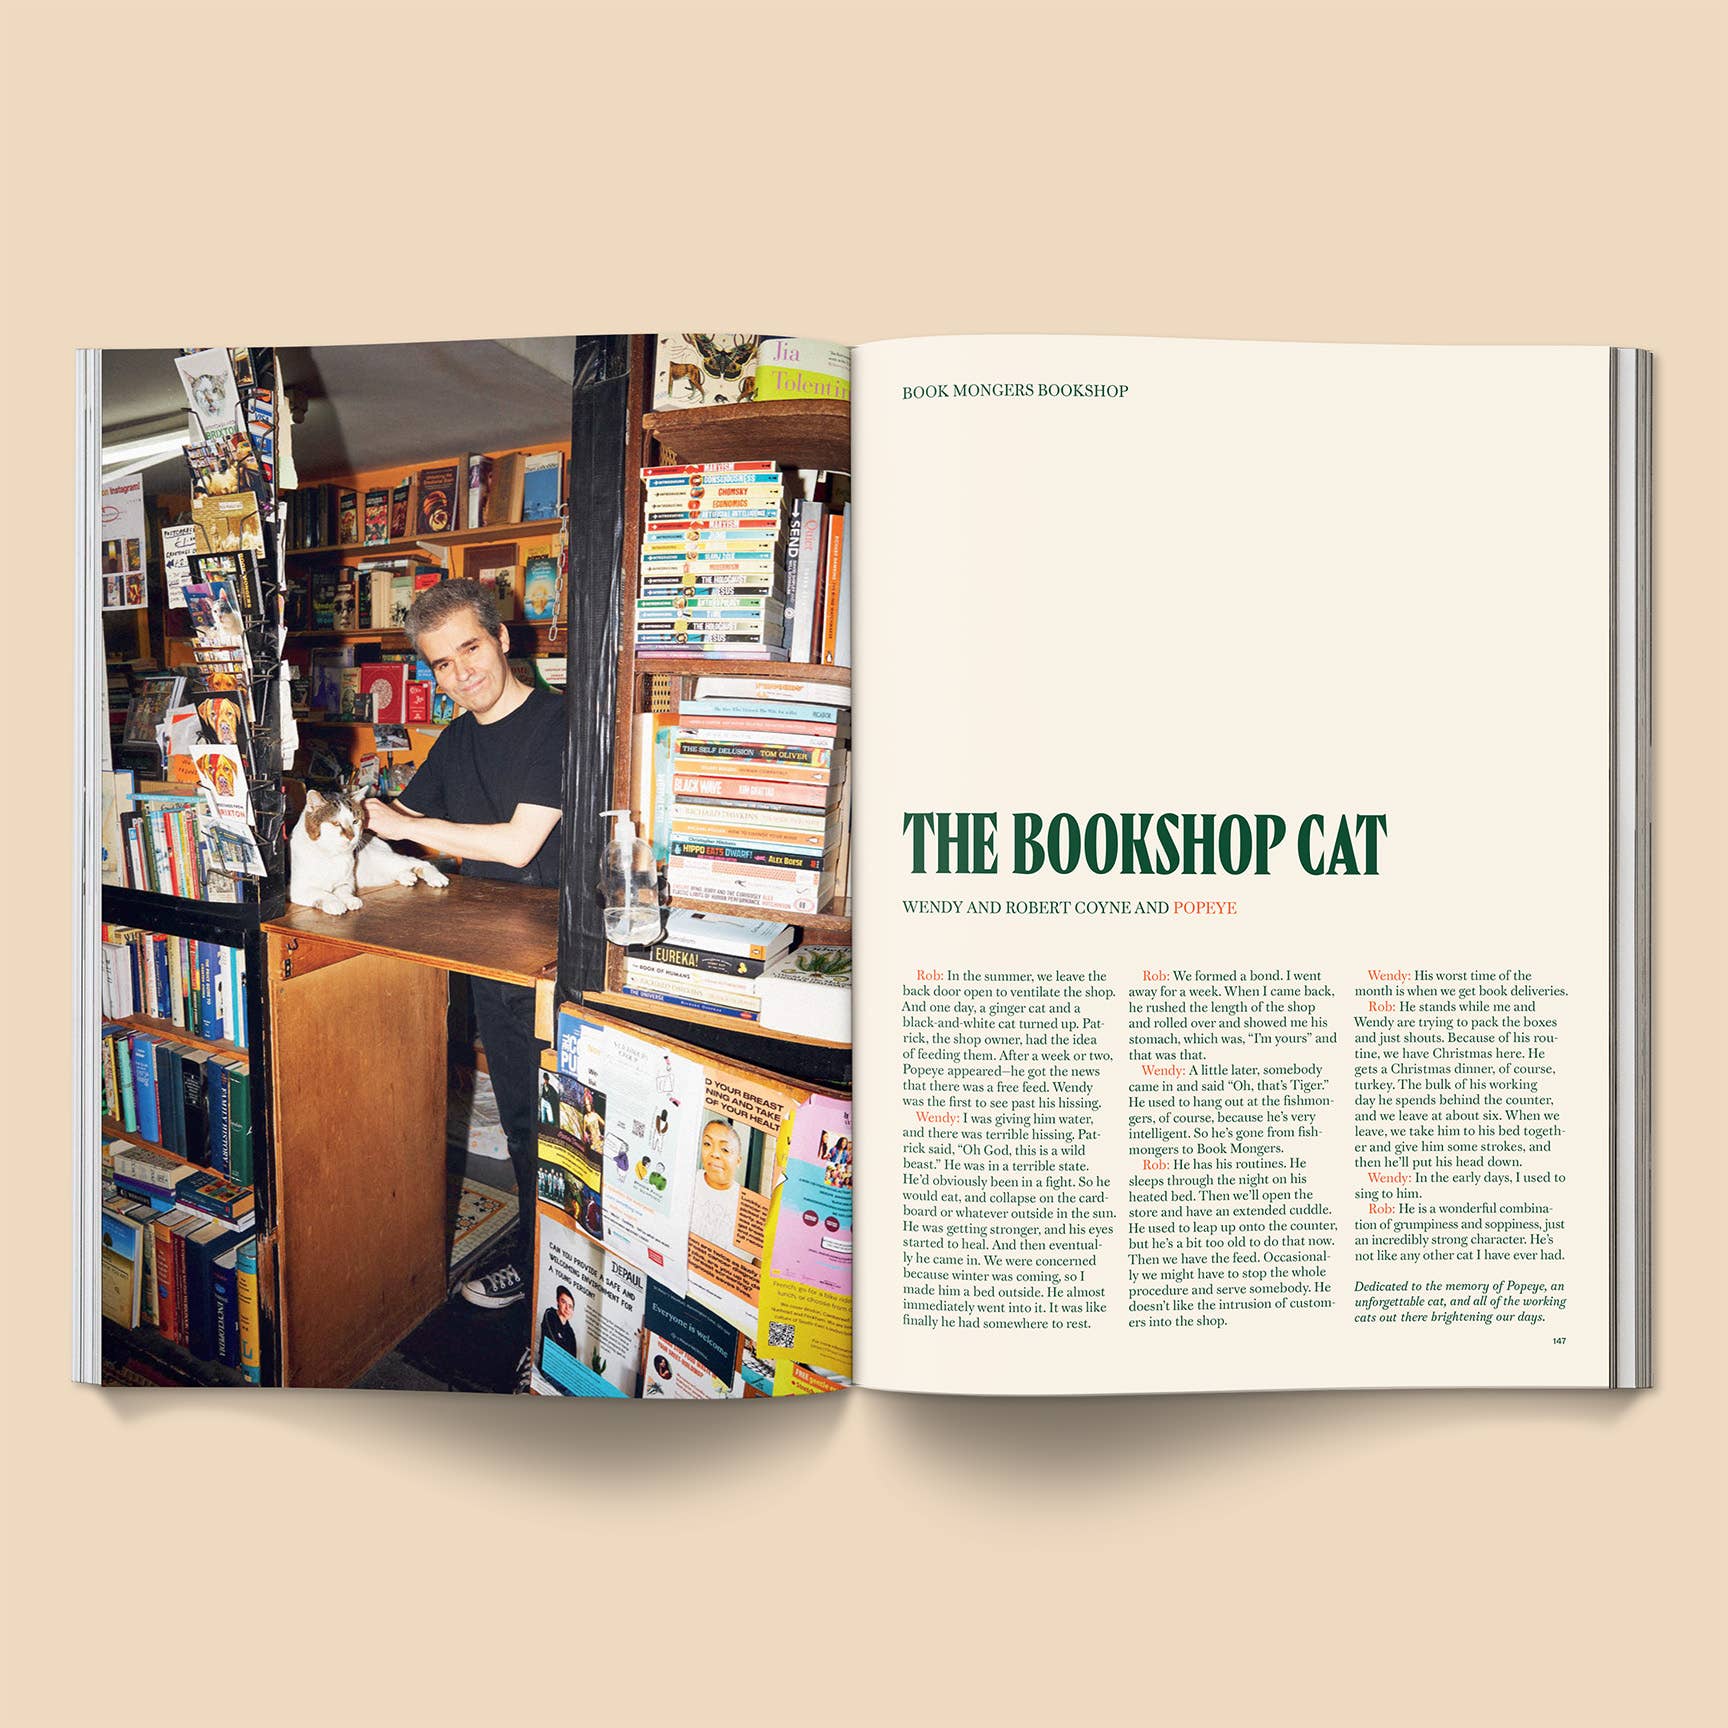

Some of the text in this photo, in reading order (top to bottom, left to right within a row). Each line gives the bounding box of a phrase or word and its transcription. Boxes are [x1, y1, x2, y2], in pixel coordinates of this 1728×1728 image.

[773, 341, 800, 361] Jia
[902, 383, 1129, 401] BOOK MONGERS BOOKSHOP
[718, 488, 748, 497] CHOMSKY
[712, 499, 748, 509] ECONOMICS
[788, 519, 800, 557] SEND
[683, 745, 808, 761] THE SELF DELUSION TOM OLIVER
[674, 778, 699, 793] BLACK
[700, 780, 723, 795] WAVE
[683, 844, 705, 854] HIPPO
[706, 847, 724, 856] EATS
[725, 849, 753, 859] DWARF!
[902, 811, 1389, 877] THE BOOKSHOP CAT
[901, 900, 1238, 915] WENDY AND ROBERT COYNE AND POPEYE
[656, 947, 699, 968] EUREKA!
[639, 965, 691, 980] BOOK OF HUMANS
[917, 968, 1107, 982] Rob: In the summer, we leave the
[1143, 969, 1322, 982] Rob: We formed a bond. I went
[1367, 969, 1533, 985] Wendy: His worst time of the
[715, 1080, 742, 1097] YOUR
[743, 1092, 784, 1112] BREAST
[705, 1088, 782, 1123] NING AND TAKE
[705, 1096, 719, 1107] OF
[721, 1102, 749, 1120] YOUR
[549, 1242, 561, 1254] CAN
[562, 1249, 572, 1261] YOU
[574, 1258, 598, 1277] PROVIDE
[606, 1278, 621, 1293] SAFE
[622, 1289, 636, 1301] AND
[611, 1261, 643, 1289] DEPAUL
[548, 1265, 596, 1300] A YOUNG PERSON?
[549, 1253, 633, 1312] WELCOMING ENVIRONMENT FOR
[1353, 1279, 1565, 1295] Dedicated to the memory of Popeye, an
[1354, 1294, 1568, 1311] unforgettable cat, and all of the working
[1353, 1310, 1546, 1326] cats out there brightening our days.
[652, 1303, 688, 1330] Everyone
[689, 1323, 696, 1333] is
[696, 1329, 729, 1359] welcome
[1552, 1336, 1567, 1346] 147
